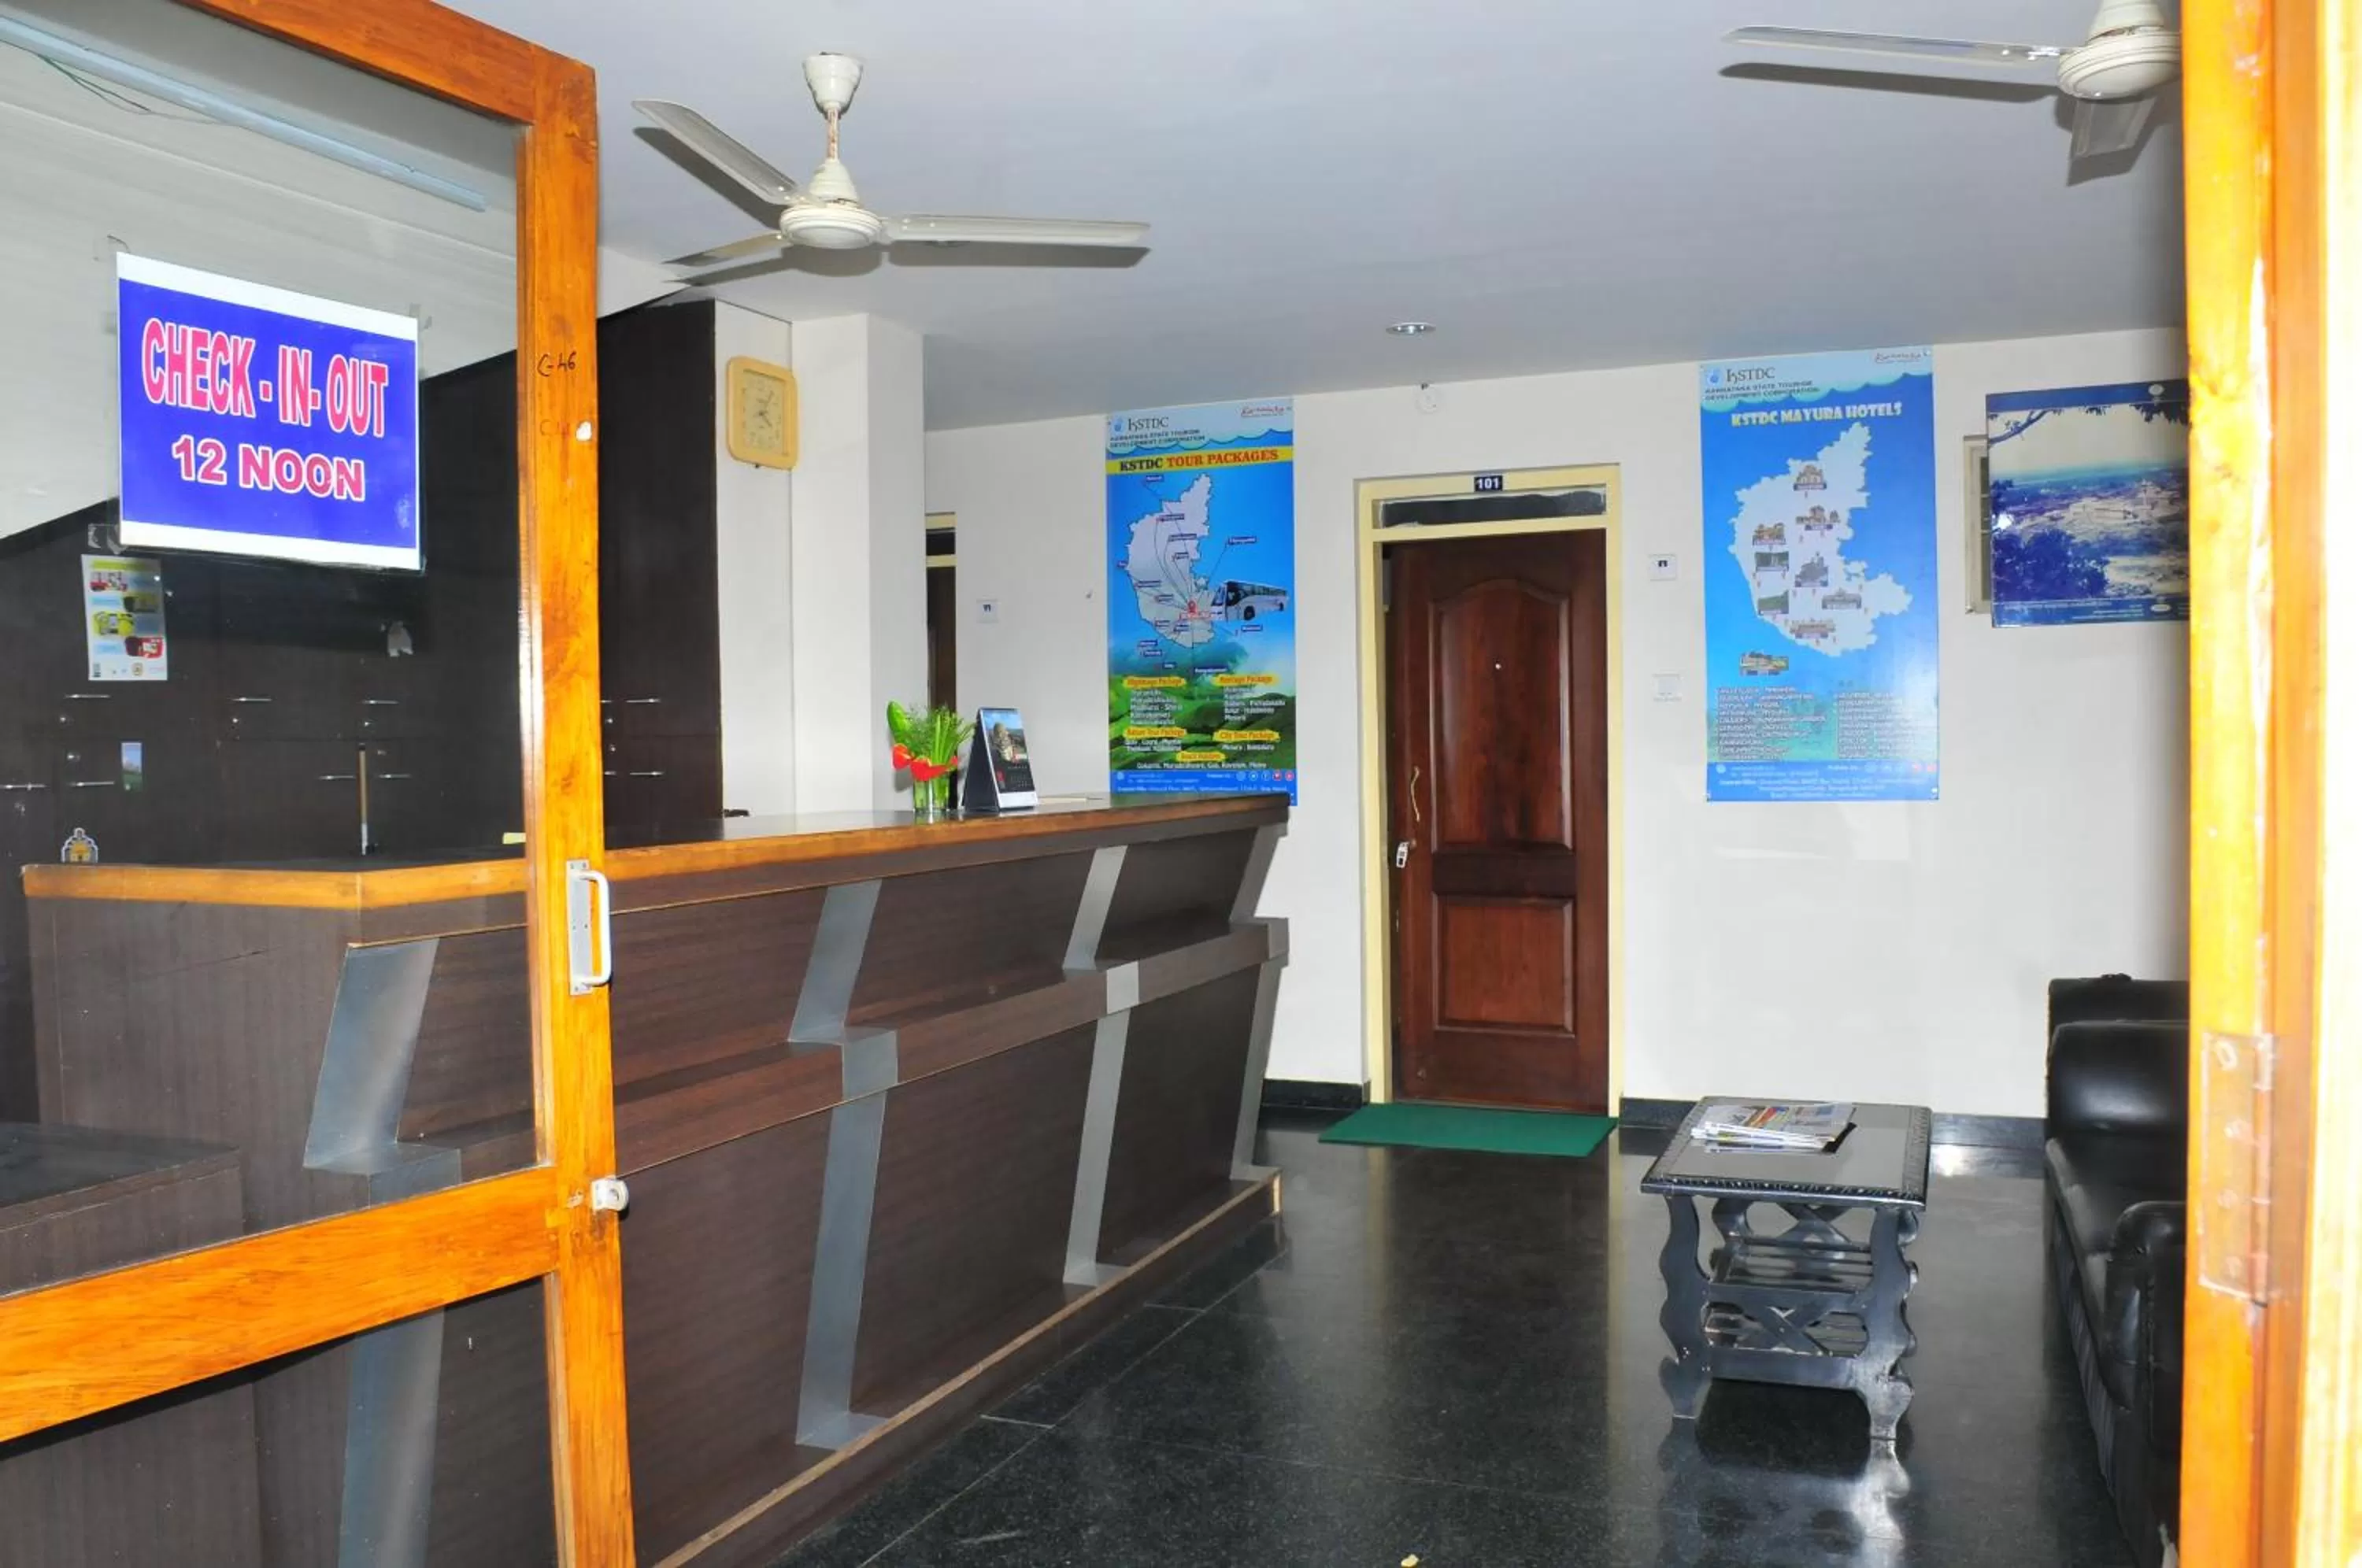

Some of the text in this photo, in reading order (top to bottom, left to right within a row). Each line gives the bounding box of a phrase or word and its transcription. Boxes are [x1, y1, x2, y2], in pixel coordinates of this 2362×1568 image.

[142, 318, 256, 418] CHECK
[327, 356, 389, 438] OUT
[1726, 367, 1775, 383] KSTDC
[1127, 416, 1169, 431] KSTDC
[1731, 401, 1902, 427] KSTDC MAYURA HOTELS
[172, 435, 365, 501] 12 NOON
[1120, 449, 1279, 472] KSTDC TOUR PACKAGES
[1476, 477, 1500, 490] 101
